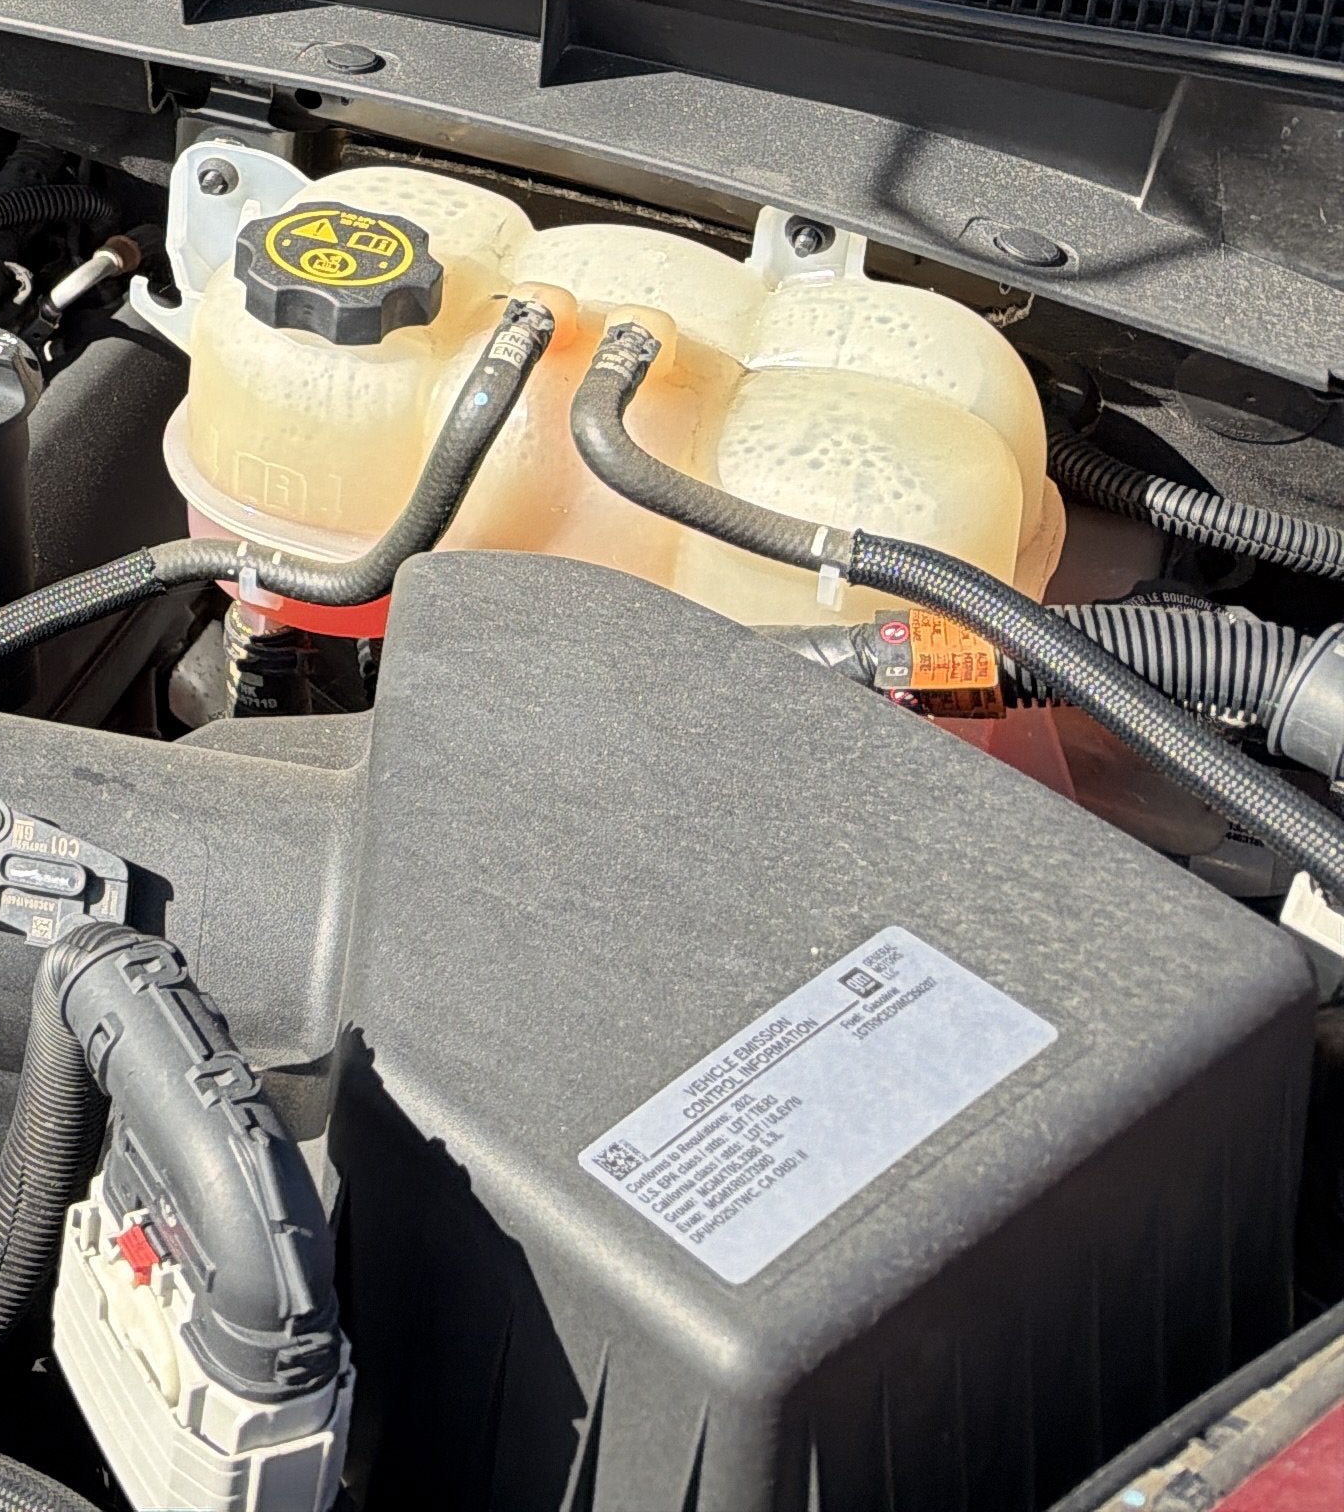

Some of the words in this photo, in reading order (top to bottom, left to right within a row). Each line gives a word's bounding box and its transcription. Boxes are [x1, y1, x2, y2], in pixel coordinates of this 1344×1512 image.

[1146, 592, 1160, 603] LE
[1162, 592, 1213, 611] BOUCHON
[51, 836, 80, 858] C01
[683, 1057, 738, 1096] VEHICLE
[734, 1017, 792, 1060] EMISSION
[683, 1077, 743, 1119] CONTROL
[738, 1018, 818, 1076] INFORMATION
[626, 1160, 671, 1193] Conforms
[668, 1152, 680, 1161] to
[677, 1115, 731, 1153] Regulations:
[732, 1094, 755, 1112] 2021
[638, 1188, 660, 1203] U.S.
[657, 1173, 679, 1189] EPA
[678, 1155, 702, 1174] class
[705, 1138, 727, 1153] stds:
[728, 1117, 747, 1134] LDT
[749, 1095, 778, 1115] TIER3
[652, 1180, 696, 1213] California
[694, 1162, 718, 1181] class
[721, 1144, 742, 1159] stds:
[744, 1124, 764, 1142] LDT
[766, 1097, 802, 1124] ULEV70
[664, 1198, 695, 1222] Group:
[760, 1131, 783, 1147] 5.3L
[758, 1176, 777, 1189] CA
[676, 1213, 705, 1233] Evap:
